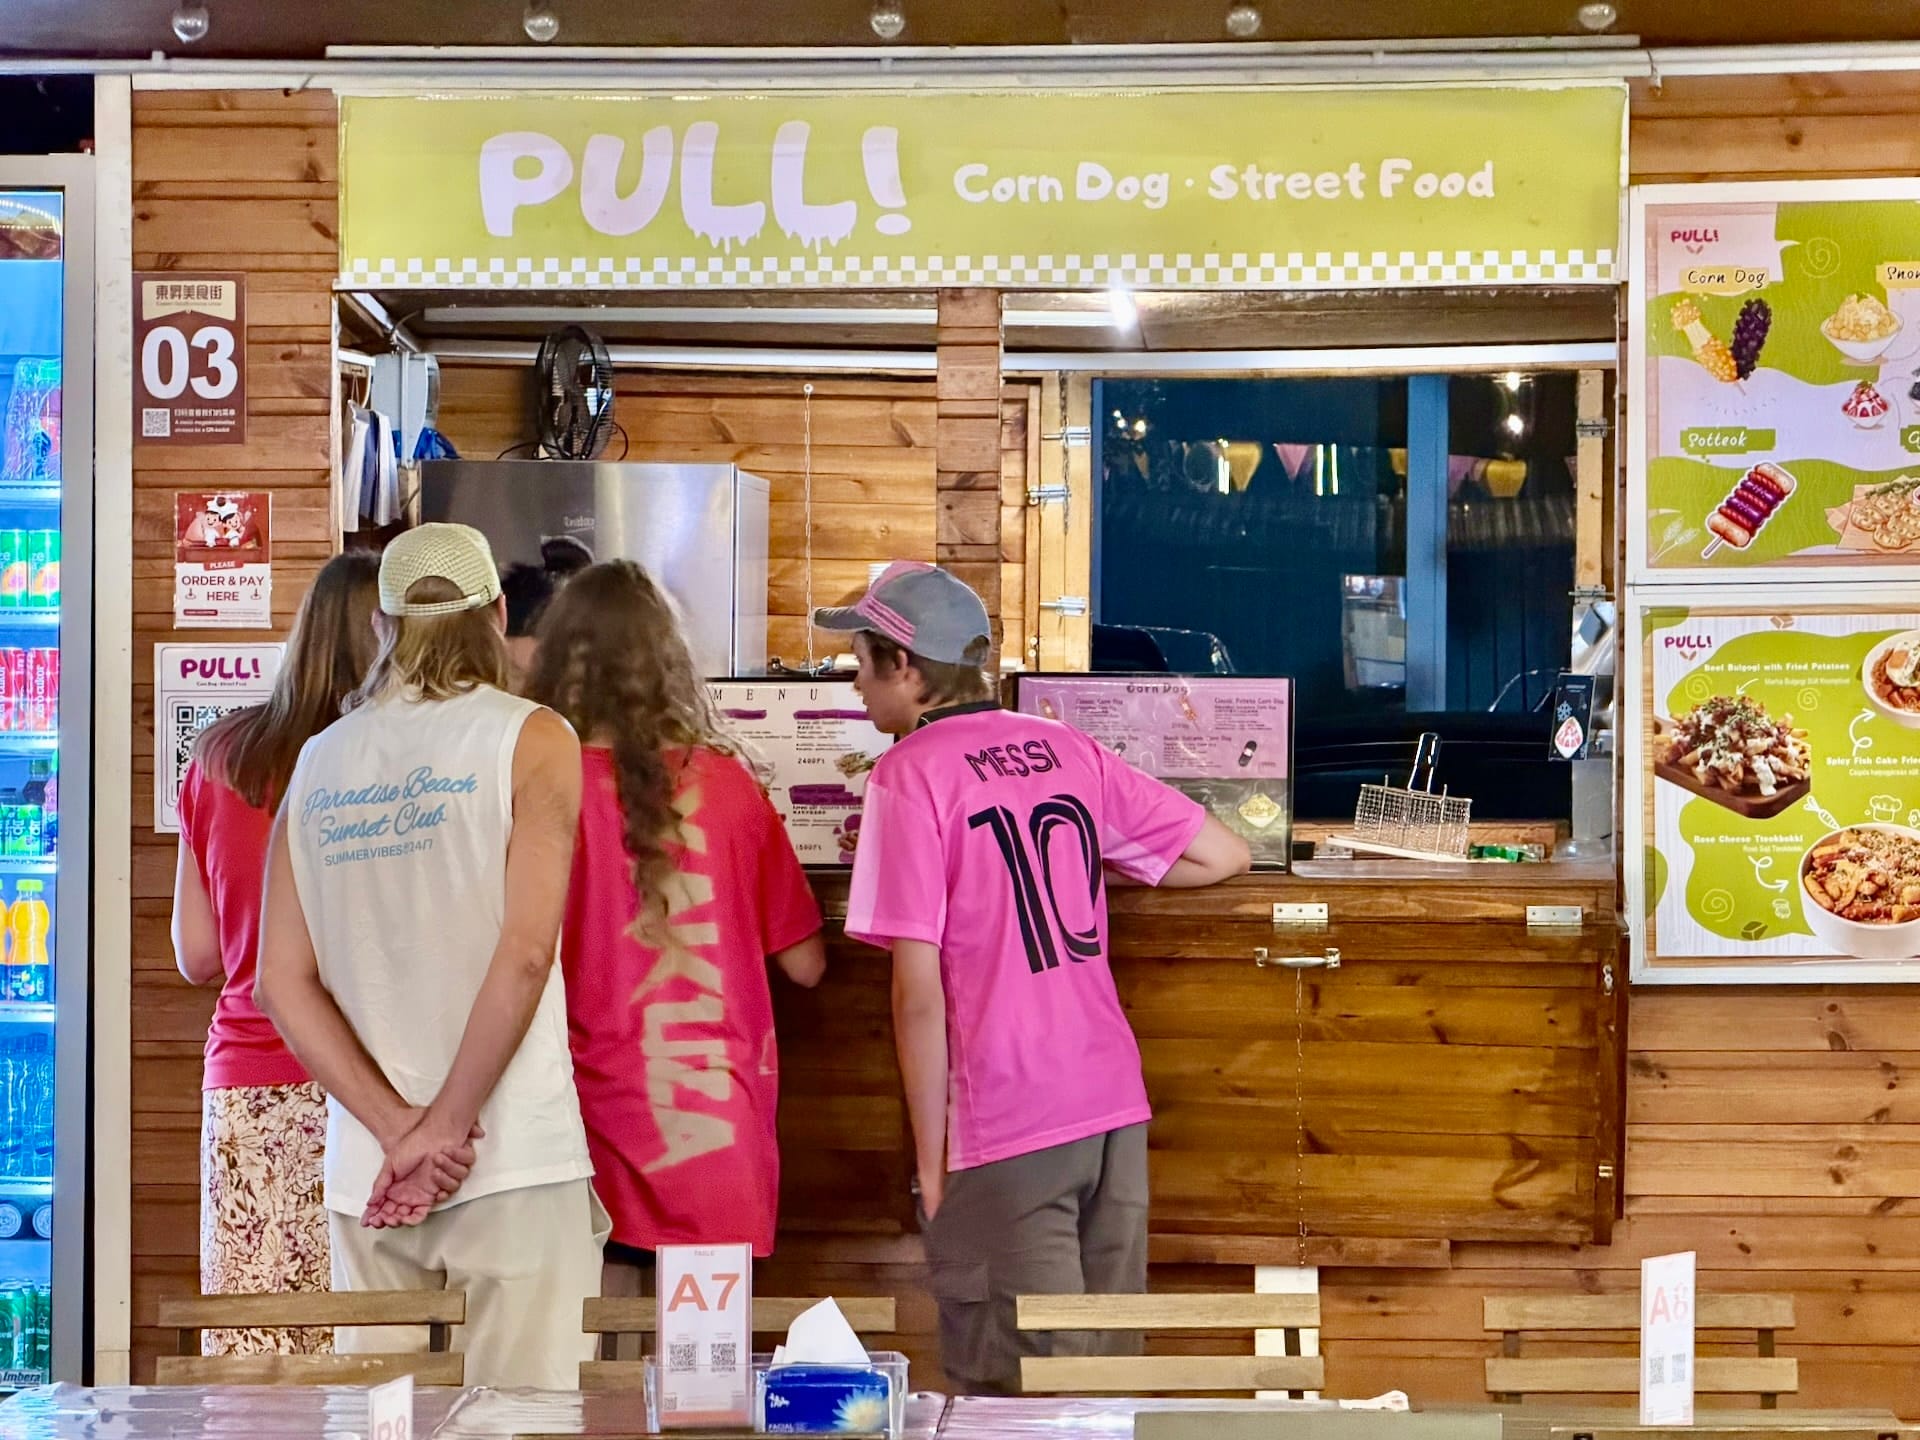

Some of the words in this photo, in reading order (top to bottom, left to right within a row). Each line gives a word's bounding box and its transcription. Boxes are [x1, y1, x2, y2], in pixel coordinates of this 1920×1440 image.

[479, 120, 911, 254] PULL!
[953, 163, 1064, 203] Corn
[1075, 161, 1169, 209] Dog
[1207, 162, 1367, 200] Street
[1379, 158, 1495, 200] Food
[1671, 229, 1719, 243] PULL!
[1688, 270, 1725, 284] Corn
[1735, 269, 1765, 288] Dog
[142, 326, 238, 399] 03
[210, 561, 236, 569] PLEASE
[182, 576, 225, 585] ORDER
[228, 576, 236, 585] &
[239, 576, 265, 585] PAY
[206, 591, 239, 601] HERE
[1664, 635, 1712, 649] PULL!
[180, 657, 260, 679] PULL!
[1126, 682, 1159, 693] Corn
[964, 739, 1062, 782] MESSI
[302, 783, 400, 826] Paradise
[403, 766, 477, 798] Beach
[318, 813, 392, 848] Sunset
[394, 801, 447, 836] Club
[968, 794, 1103, 974] 10
[667, 1272, 740, 1313] A7
[3, 1371, 41, 1382] Imbera
